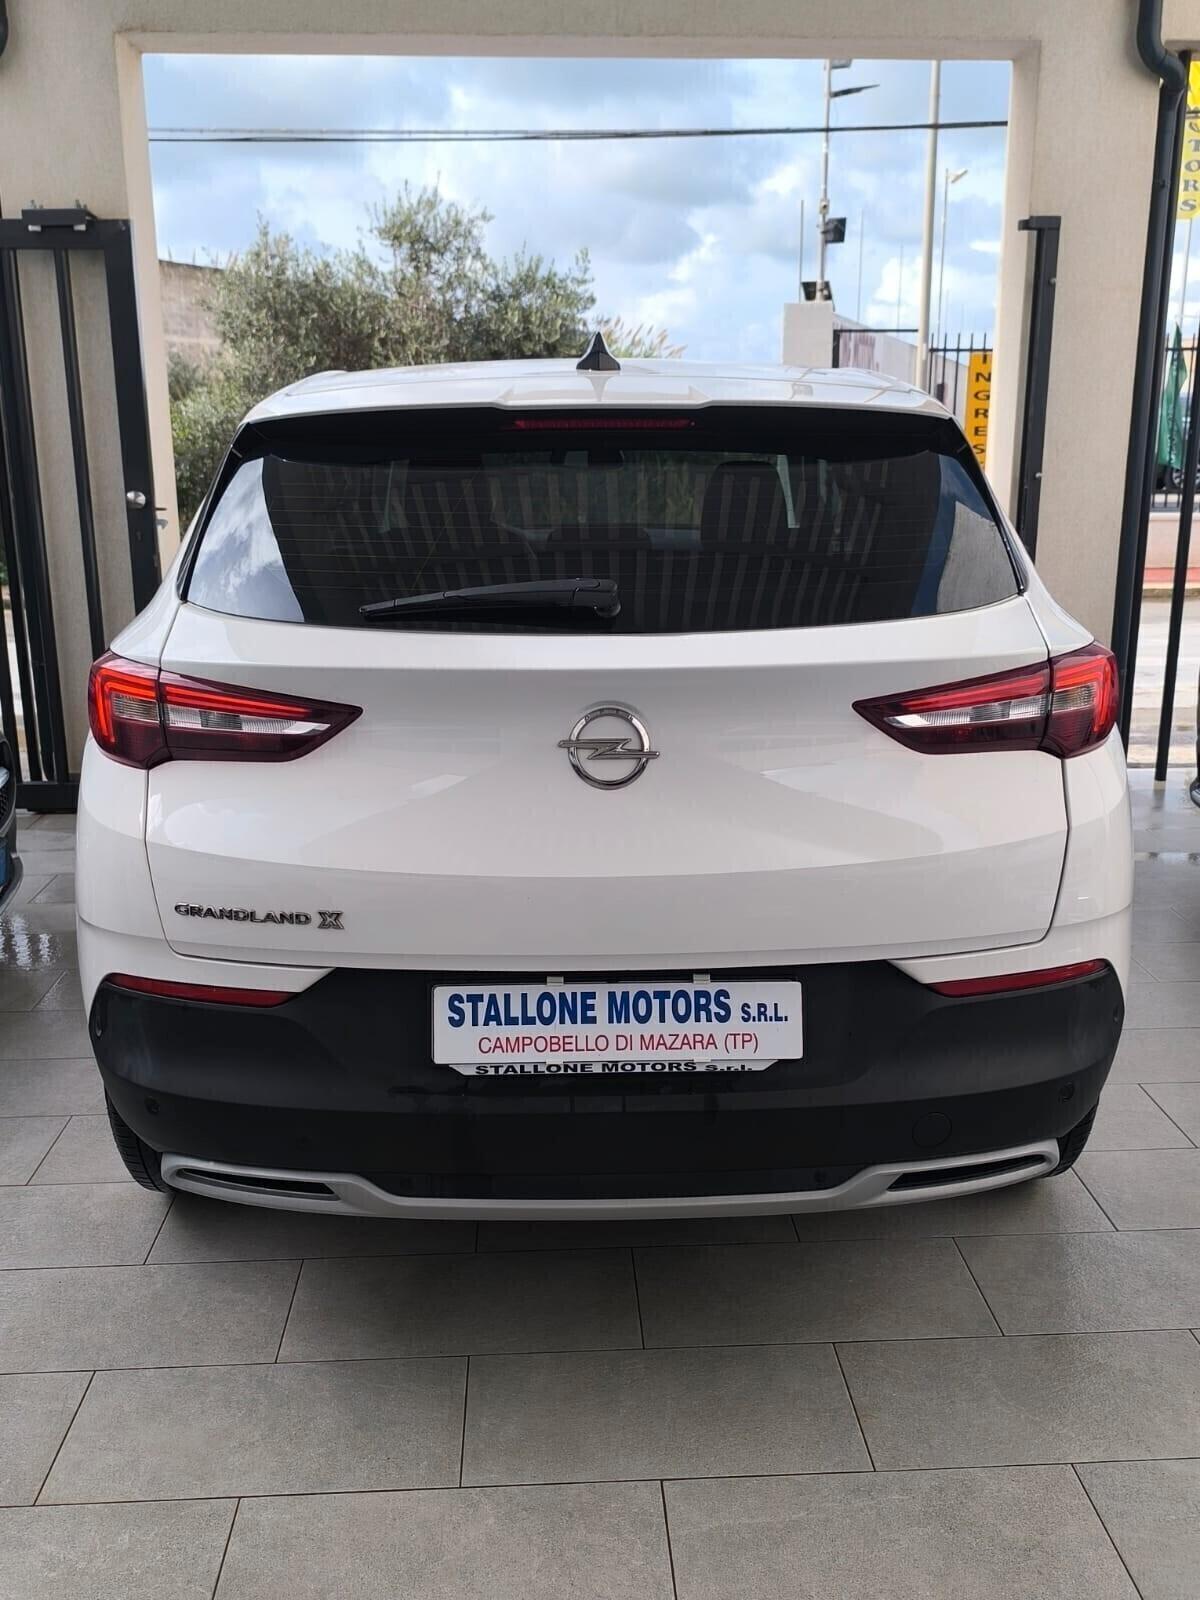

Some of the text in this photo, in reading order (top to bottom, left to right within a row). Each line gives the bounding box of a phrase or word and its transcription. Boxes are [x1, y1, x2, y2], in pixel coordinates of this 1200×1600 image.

[972, 353, 991, 464] INGRES
[174, 903, 345, 930] GRANDLAND X
[448, 989, 789, 1028] STALLONE MOTORS S.R.L.
[478, 1033, 759, 1055] CAMPOBELLO DI MAZARA (TP)
[475, 1063, 594, 1075] STALLONE
[601, 1061, 697, 1073] MOTORS
